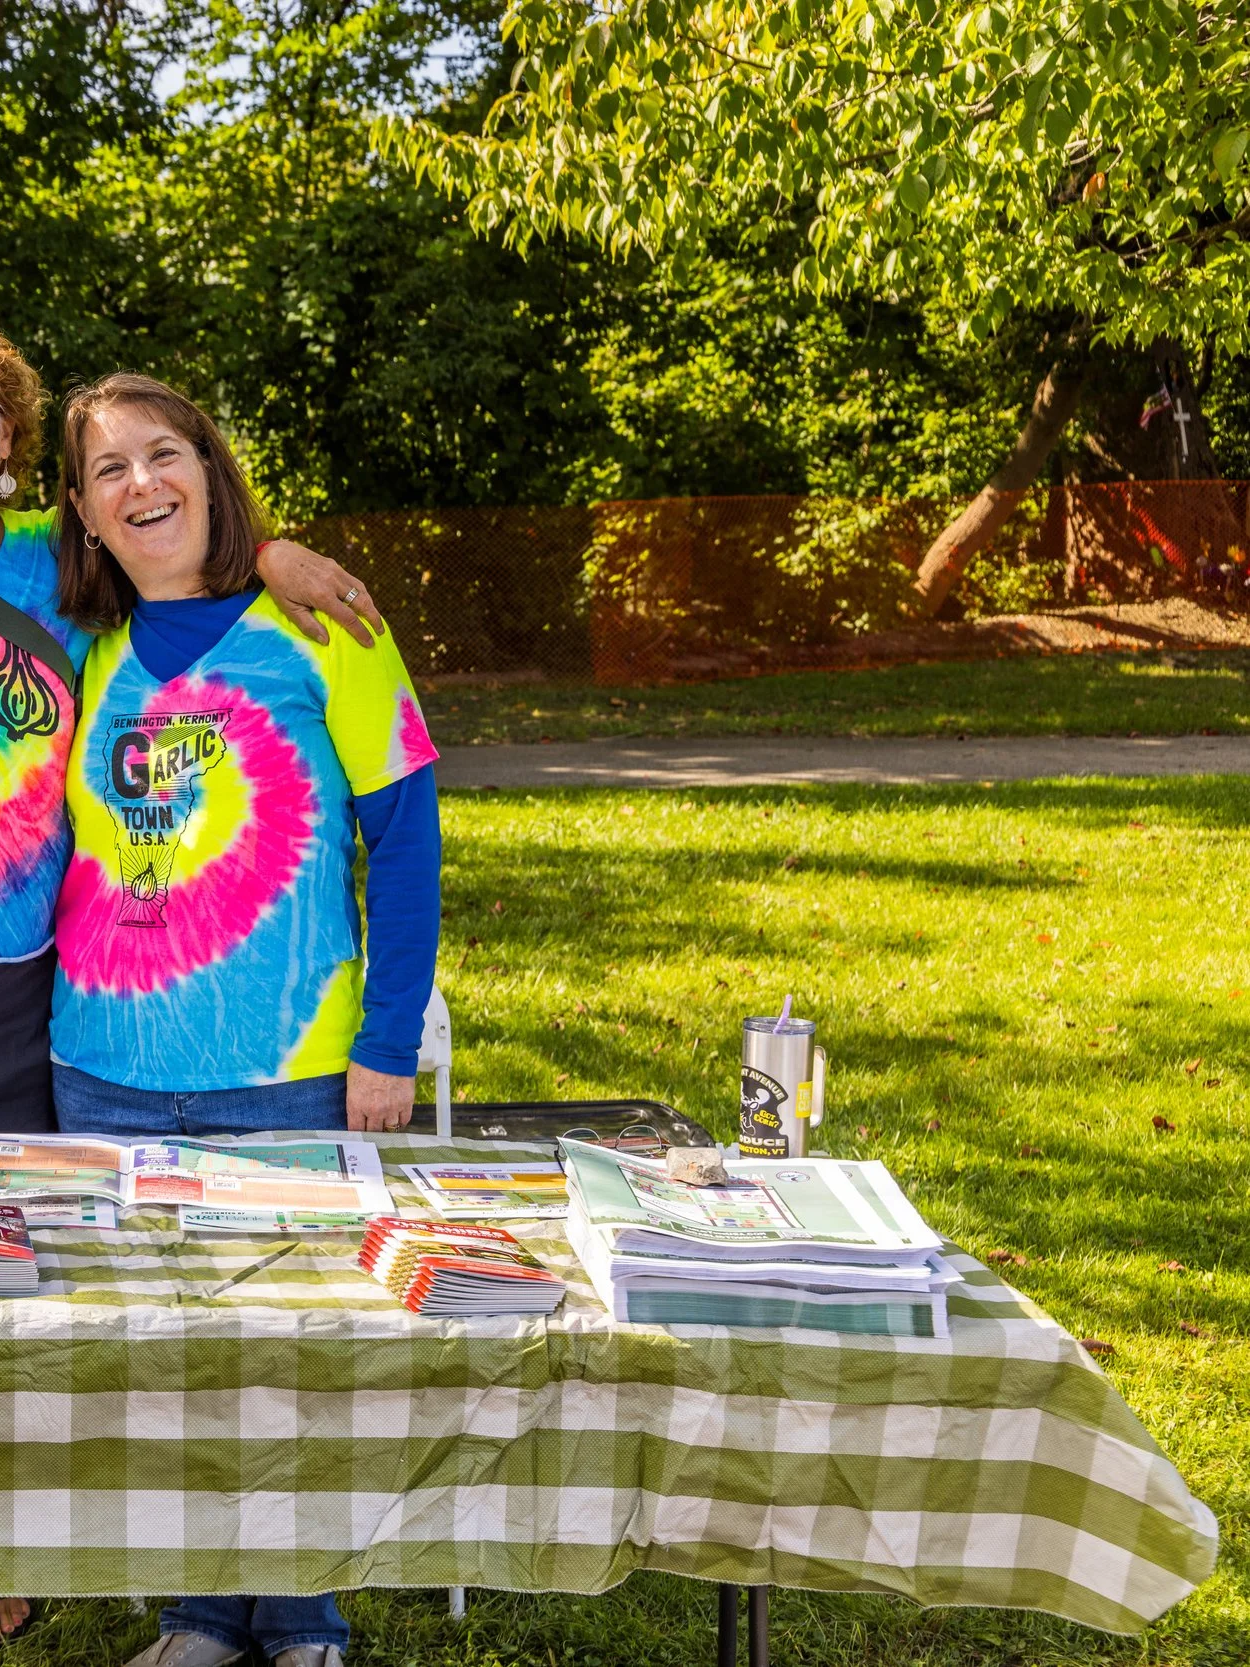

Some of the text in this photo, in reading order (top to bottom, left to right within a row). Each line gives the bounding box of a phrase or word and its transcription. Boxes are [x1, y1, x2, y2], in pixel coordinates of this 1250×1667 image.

[113, 712, 225, 728] BENNINGTON, VERMONT
[111, 729, 216, 799] GARLIC
[121, 805, 174, 830] TOWN
[130, 831, 169, 846] U.S.A.
[748, 1070, 785, 1100] AVENUE
[753, 1113, 780, 1128] CORN?
[760, 1110, 776, 1120] GOT
